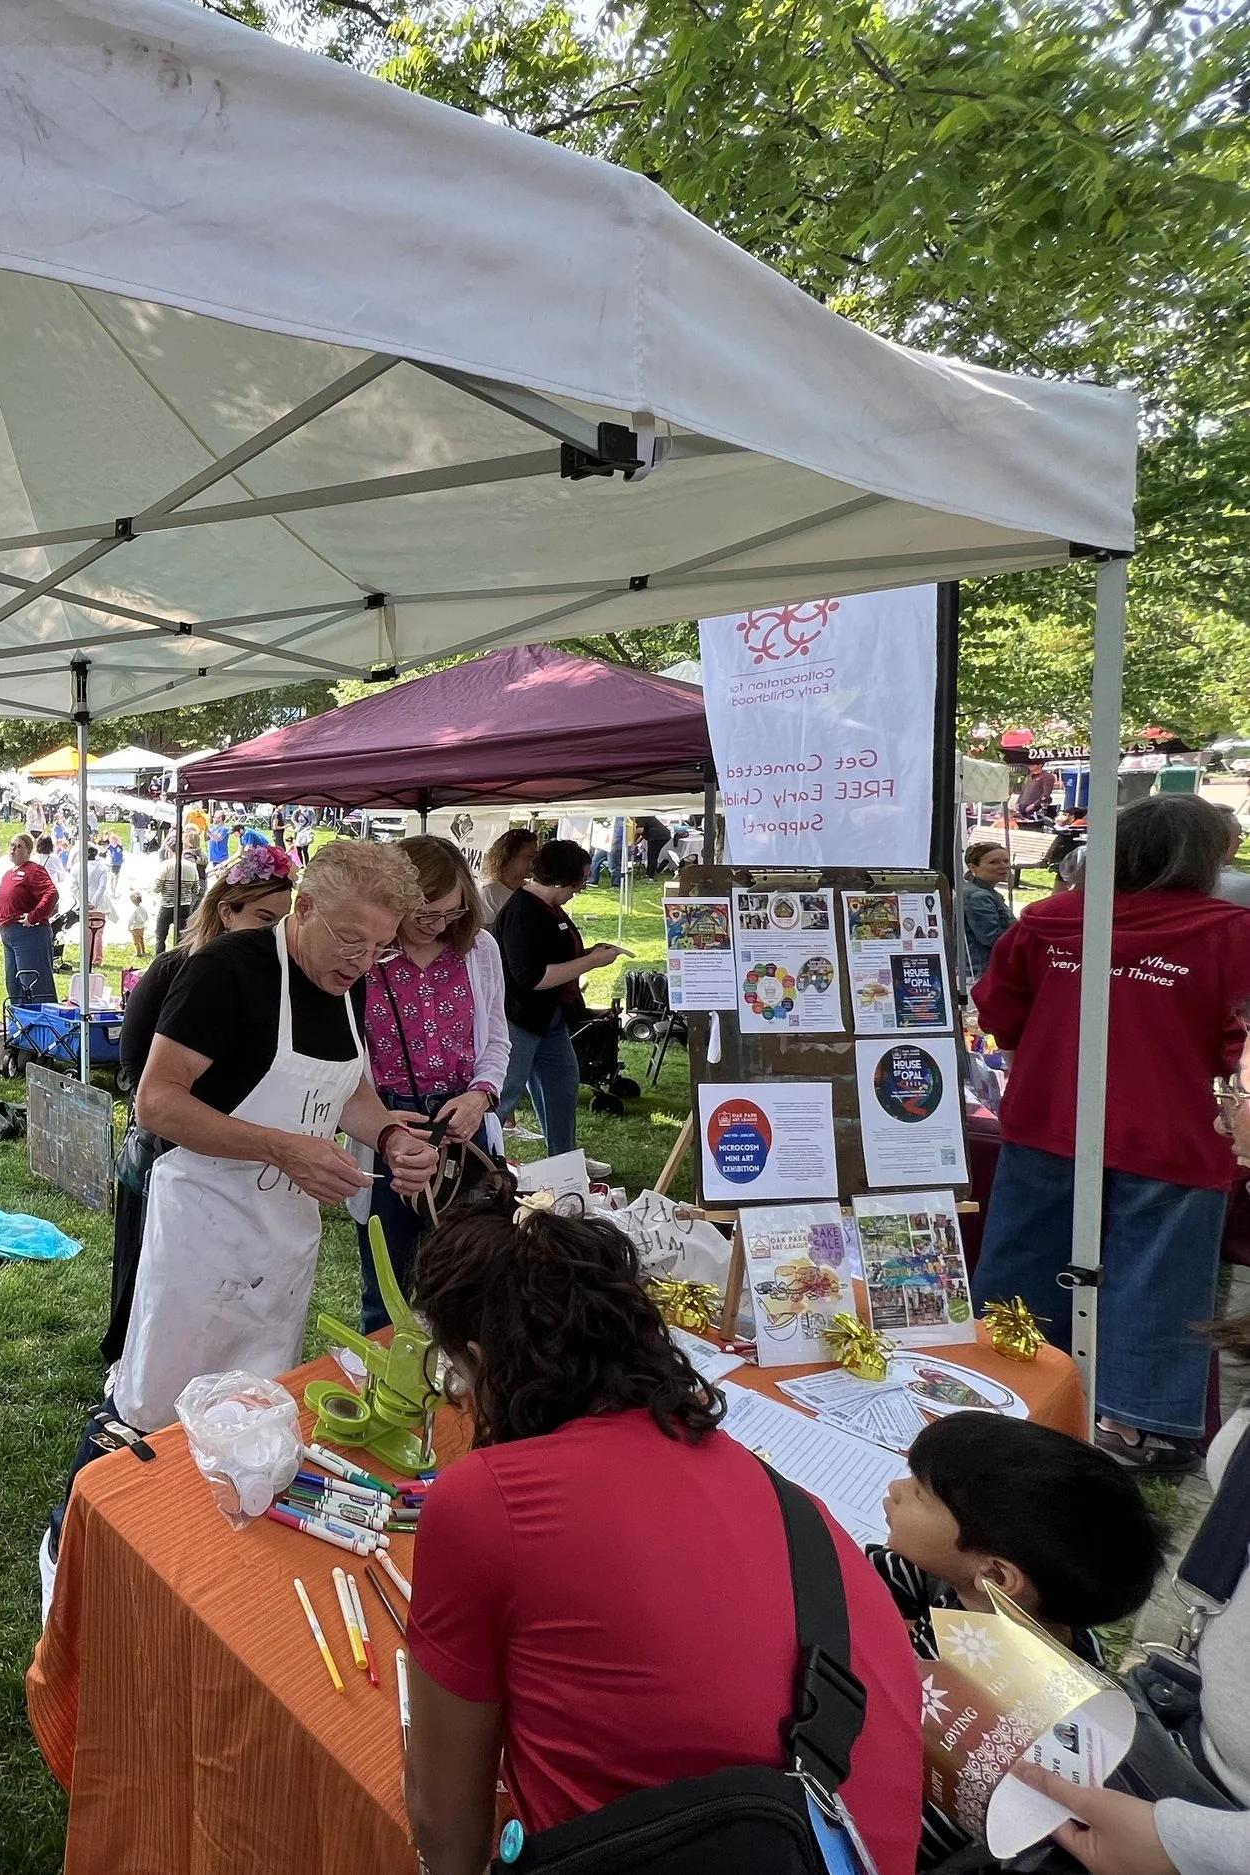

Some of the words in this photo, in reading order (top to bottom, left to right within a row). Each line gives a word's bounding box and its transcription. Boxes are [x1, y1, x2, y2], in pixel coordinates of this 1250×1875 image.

[1028, 748, 1054, 759] OAK
[1139, 955, 1189, 975] Where
[903, 968, 930, 977] HOUSE
[1049, 958, 1081, 973] very
[1128, 968, 1175, 987] Thrives
[911, 978, 931, 987] OPAL
[893, 1060, 922, 1069] HOUSE
[901, 1070, 923, 1080] OPAL
[301, 1089, 331, 1124] I'm
[812, 1226, 839, 1239] BAKE
[813, 1239, 841, 1251] SALE
[940, 1706, 978, 1751] LOVING
